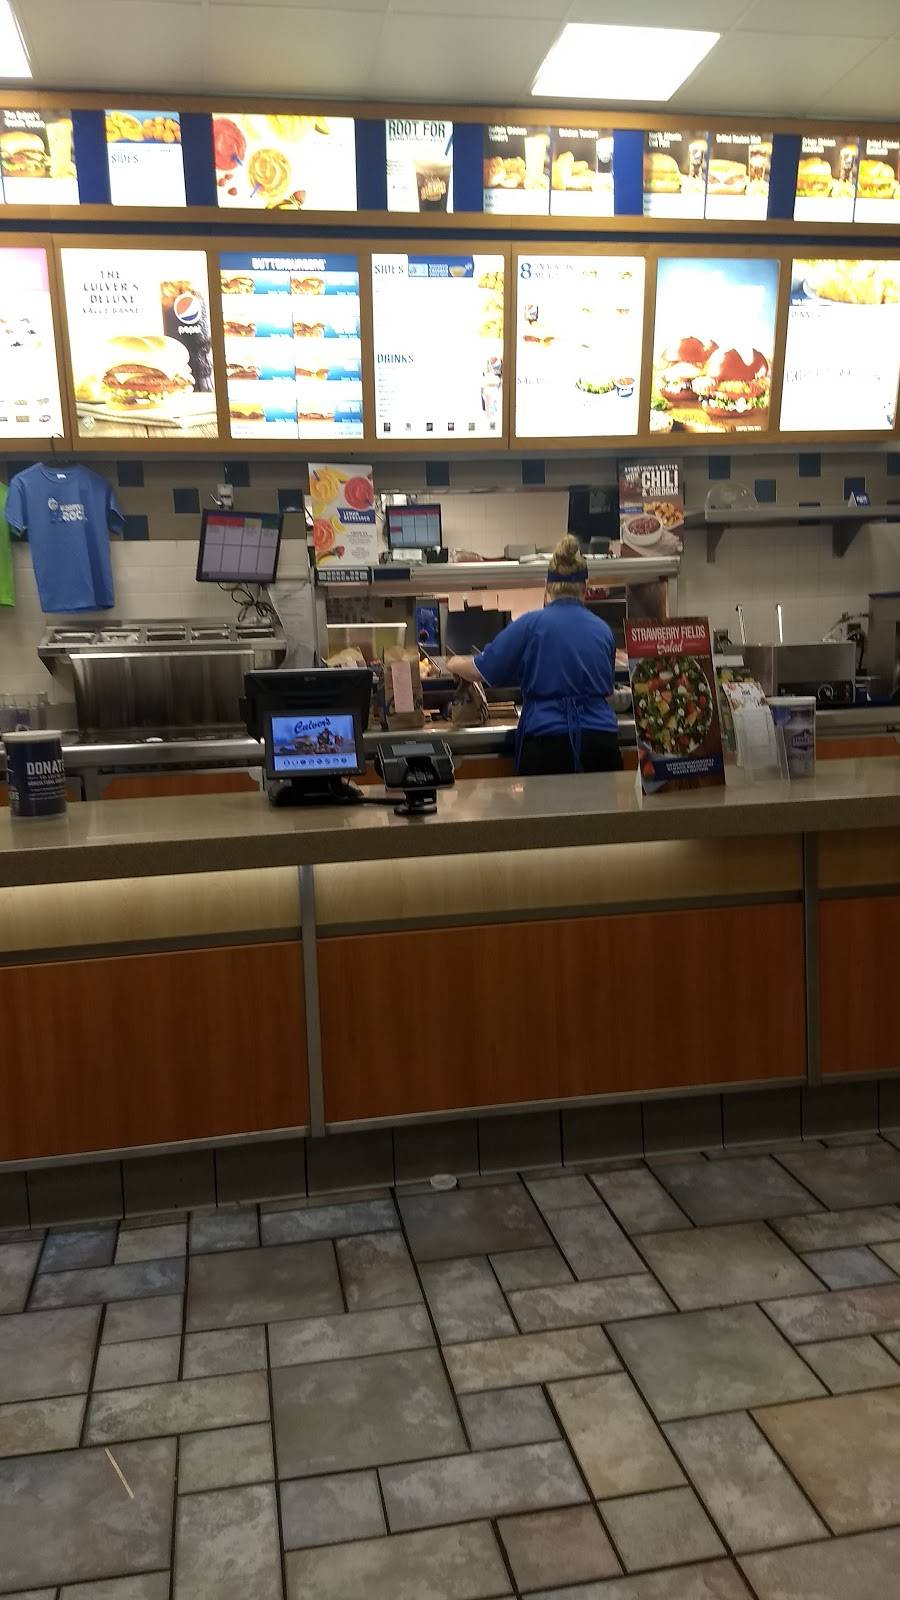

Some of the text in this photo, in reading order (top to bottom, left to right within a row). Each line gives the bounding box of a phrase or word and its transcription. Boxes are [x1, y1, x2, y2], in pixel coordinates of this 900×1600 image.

[388, 119, 445, 138] ROOT FOR
[374, 264, 404, 274] SIDES
[520, 262, 532, 279] 8
[377, 353, 414, 364] DRINKS
[641, 469, 679, 489] CHILI
[631, 625, 706, 642] STRAWBERRY FIELDS
